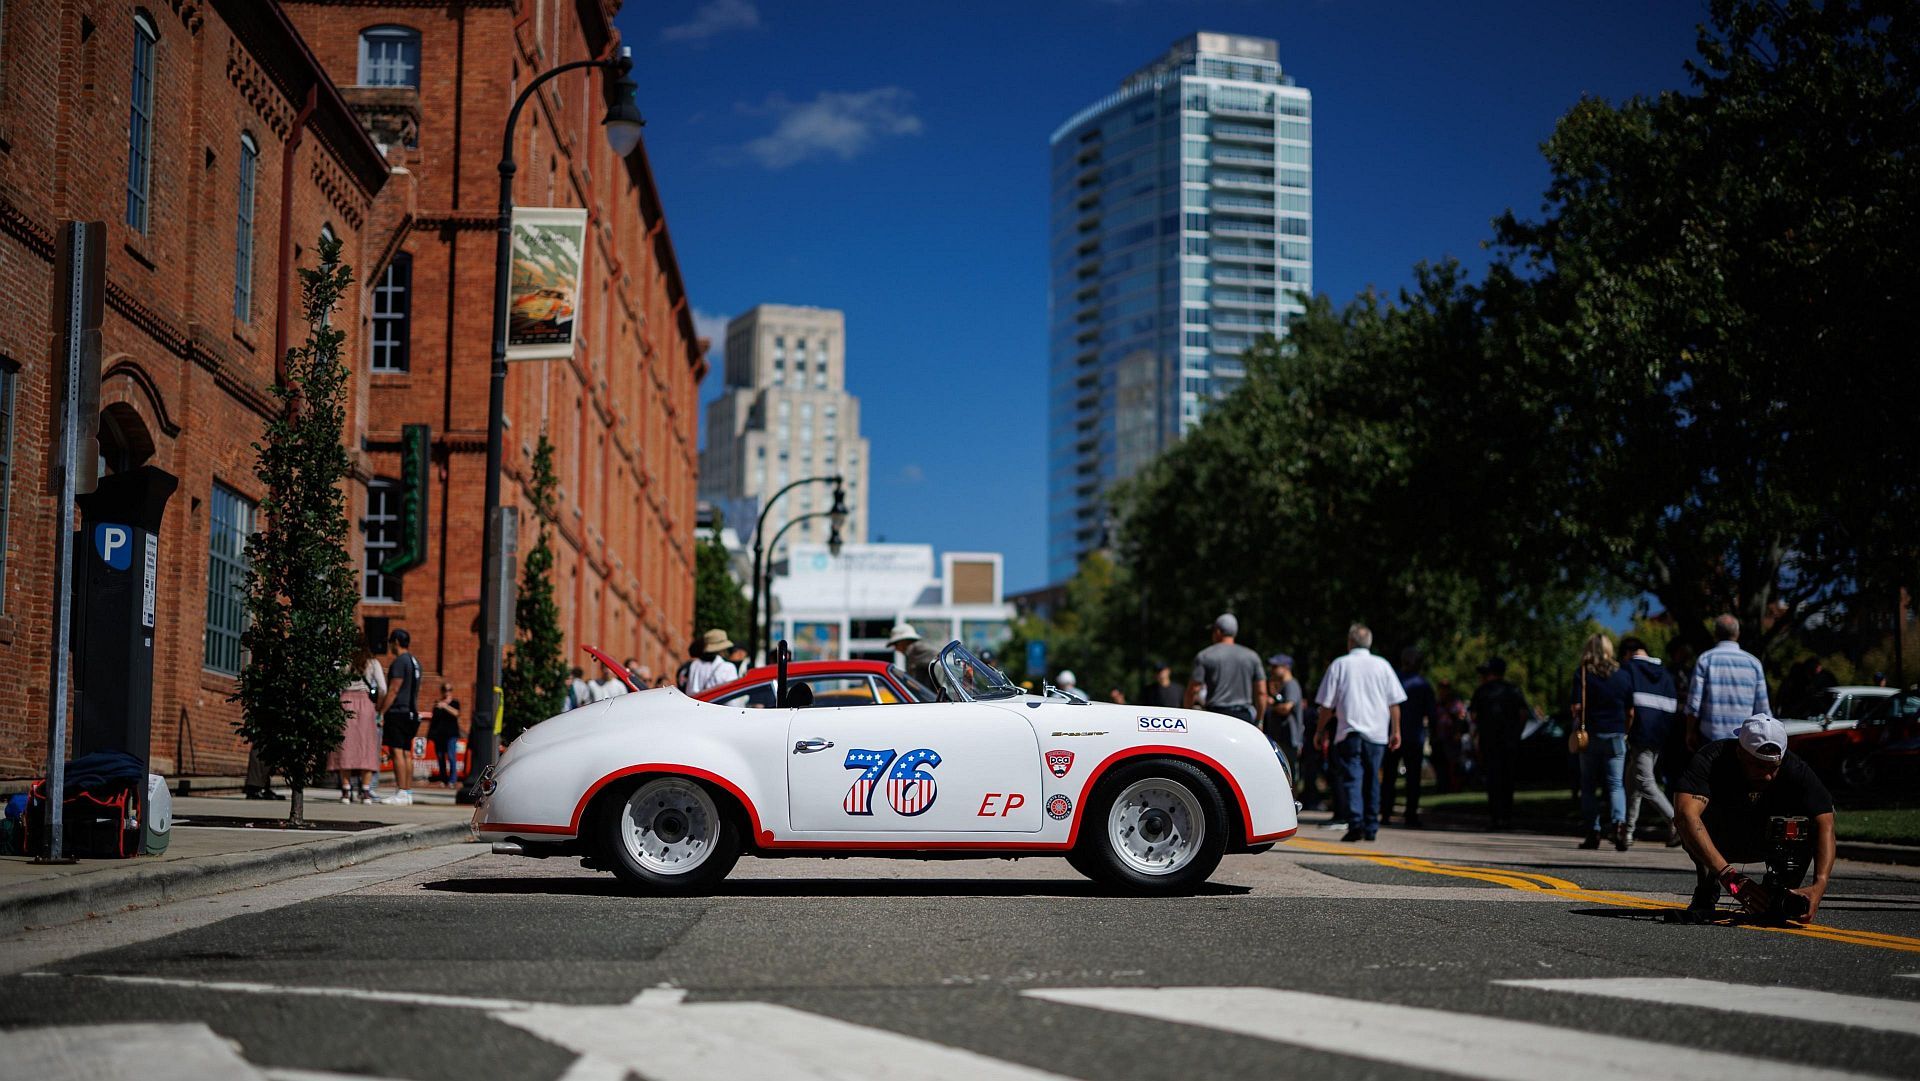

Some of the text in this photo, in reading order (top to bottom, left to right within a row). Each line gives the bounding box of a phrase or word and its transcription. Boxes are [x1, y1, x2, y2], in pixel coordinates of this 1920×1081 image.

[104, 528, 126, 560] P
[1139, 717, 1186, 729] SCCA
[843, 748, 942, 817] 76
[977, 793, 1025, 817] EP
